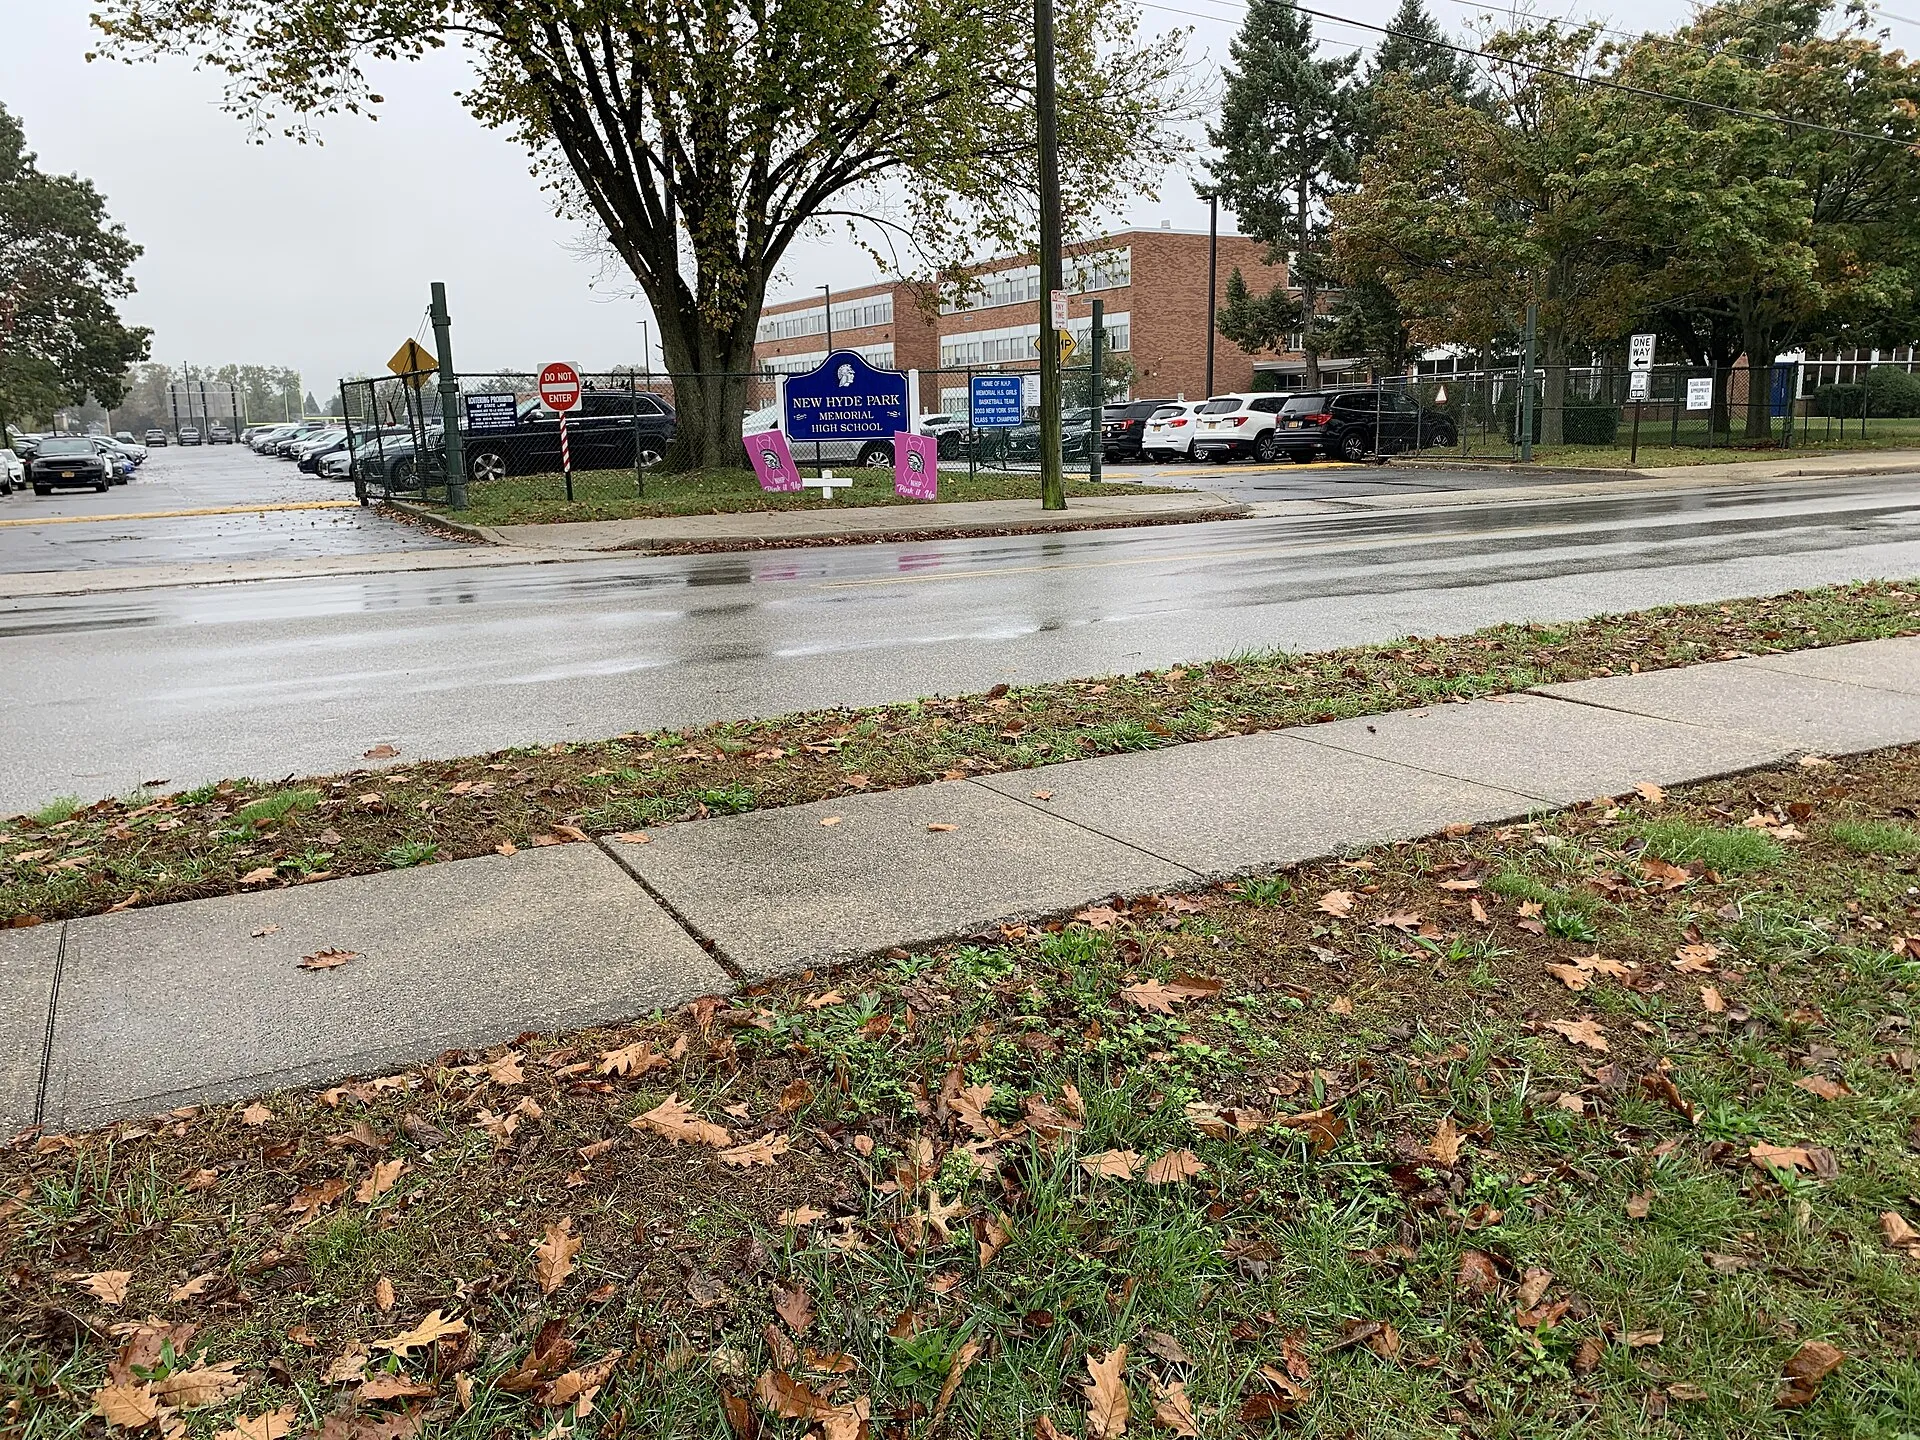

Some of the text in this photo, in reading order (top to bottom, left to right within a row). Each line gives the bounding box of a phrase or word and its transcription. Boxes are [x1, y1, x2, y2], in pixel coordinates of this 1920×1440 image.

[1634, 338, 1650, 346] ONE
[1633, 348, 1650, 356] WAY
[545, 372, 572, 381] DO NOT
[549, 394, 572, 402] ENTER
[793, 394, 900, 408] NEW HYDE PARK
[819, 411, 874, 420] MEMORIAL
[812, 423, 883, 432] HIGH SCHOOL
[790, 481, 802, 490] Up
[897, 484, 914, 494] Pink
[924, 490, 934, 500] Up
